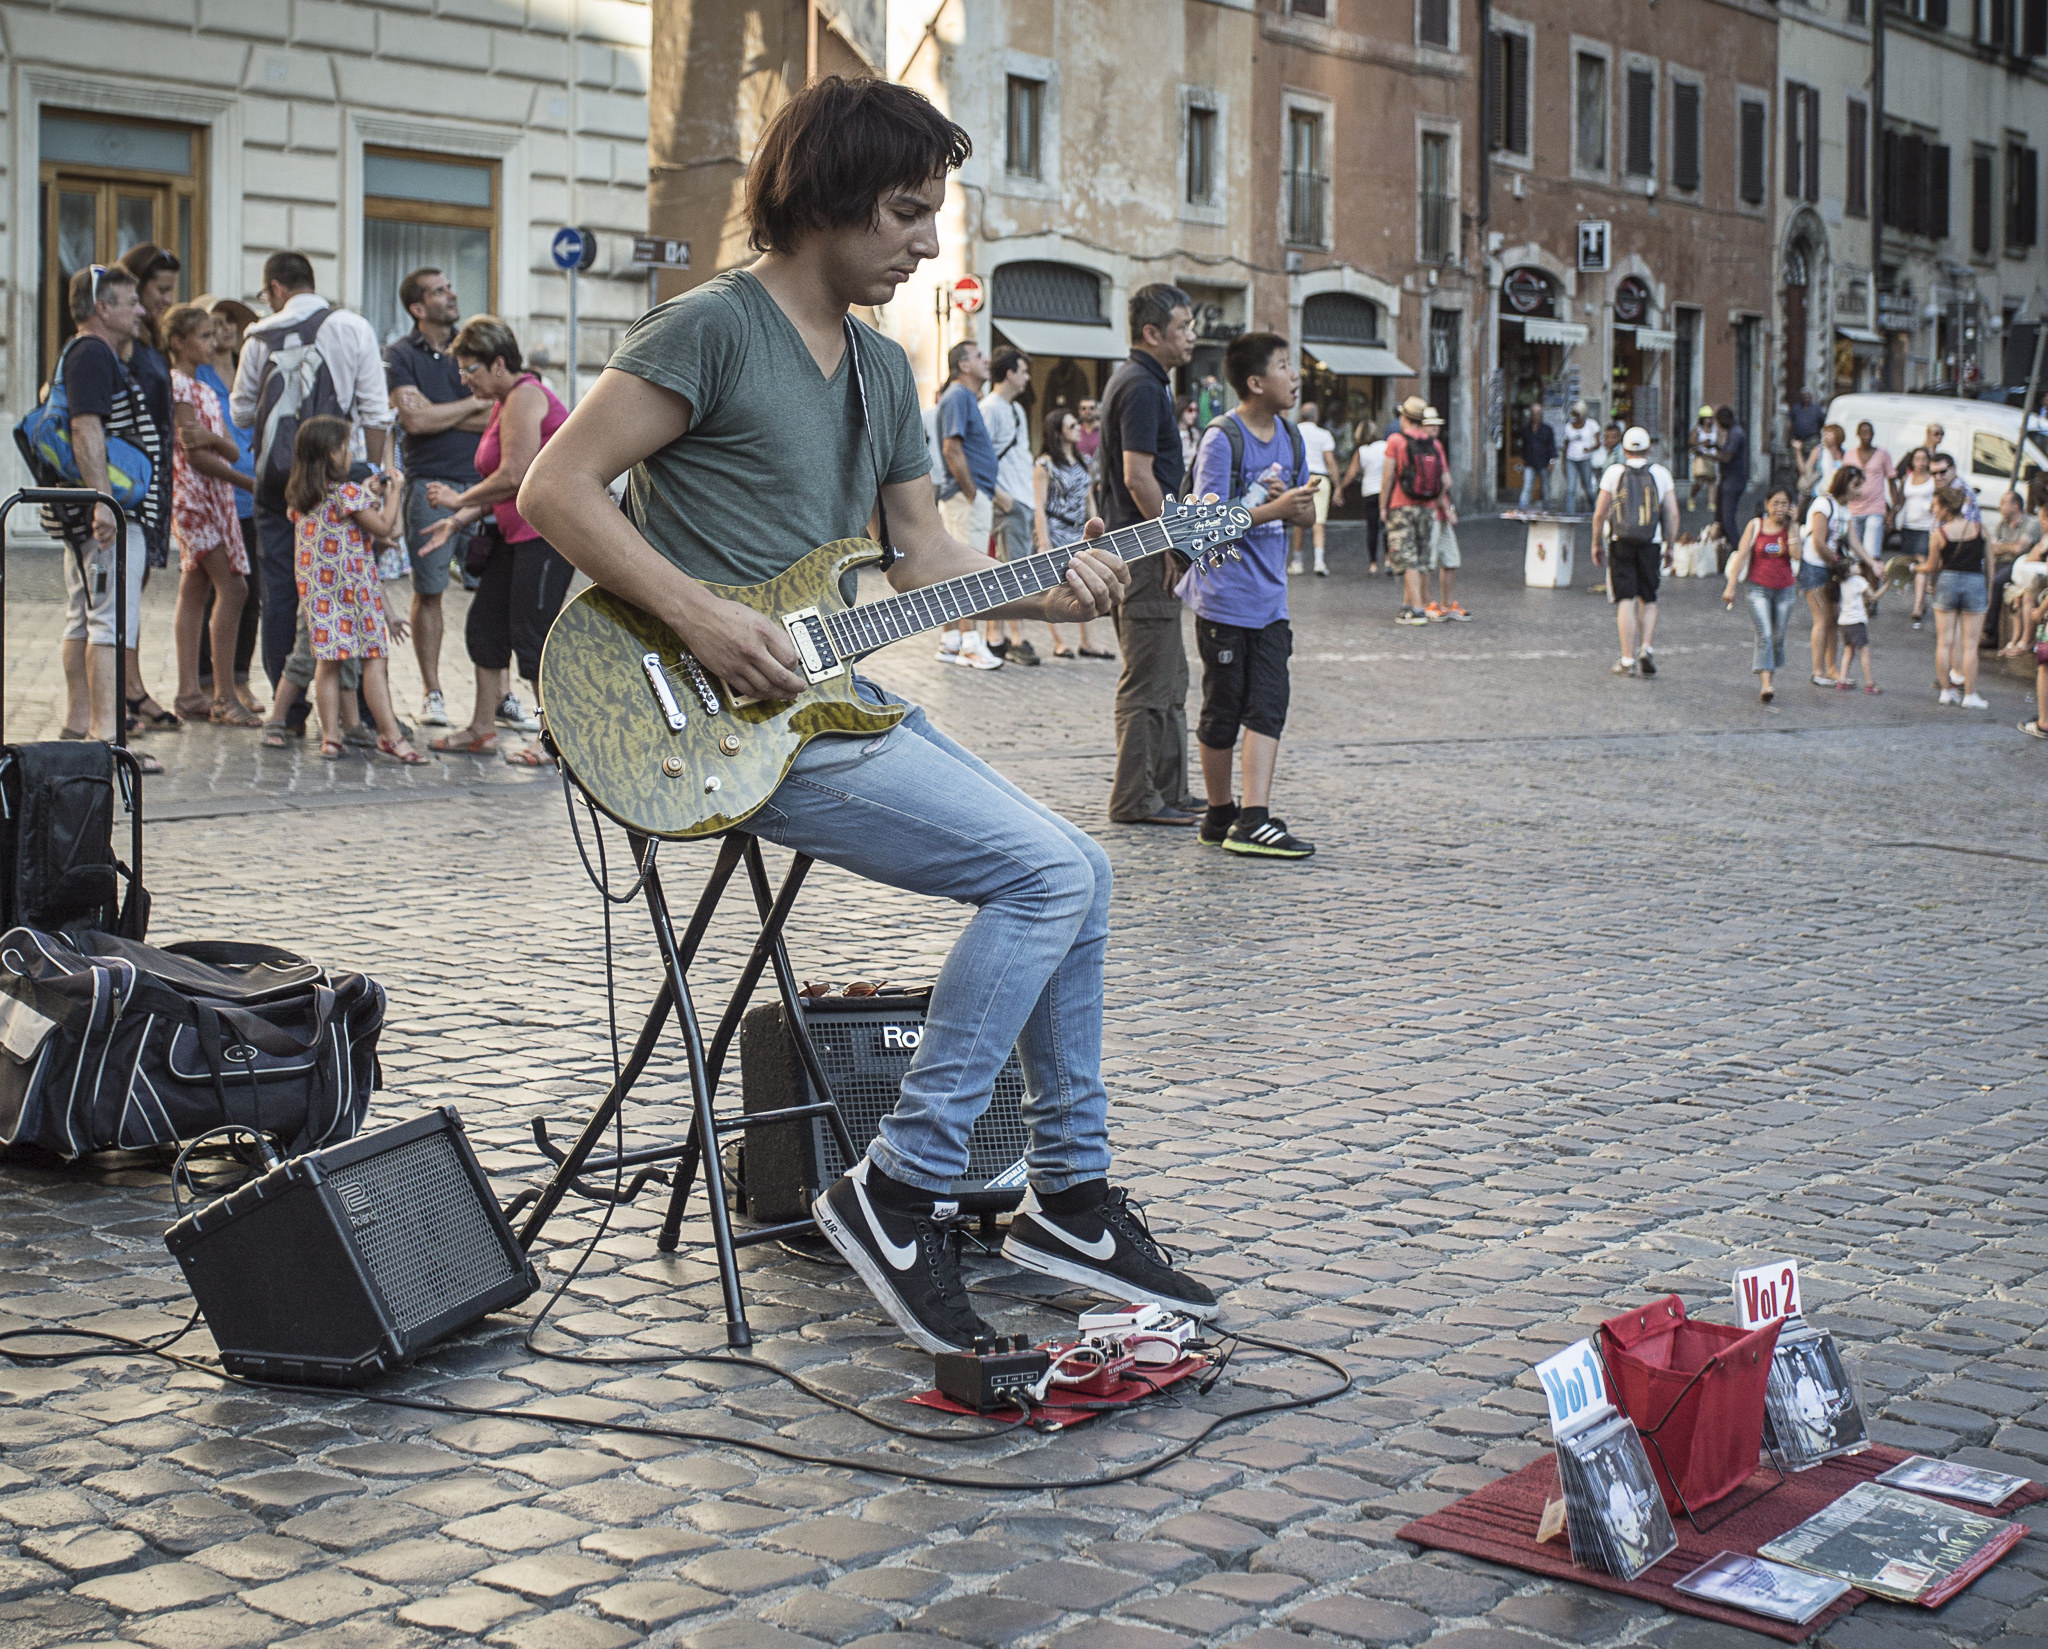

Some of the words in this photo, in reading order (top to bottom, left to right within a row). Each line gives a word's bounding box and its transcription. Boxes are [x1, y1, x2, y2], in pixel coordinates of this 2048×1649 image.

[883, 1026, 924, 1048] Rol
[822, 1218, 838, 1235] AIR
[1742, 1275, 1778, 1323] Vol
[1781, 1268, 1796, 1314] 2
[1542, 1366, 1588, 1421] Vol
[1582, 1349, 1602, 1400] 1
[1932, 1537, 1979, 1569] THANK
[1960, 1520, 1994, 1539] YOU
